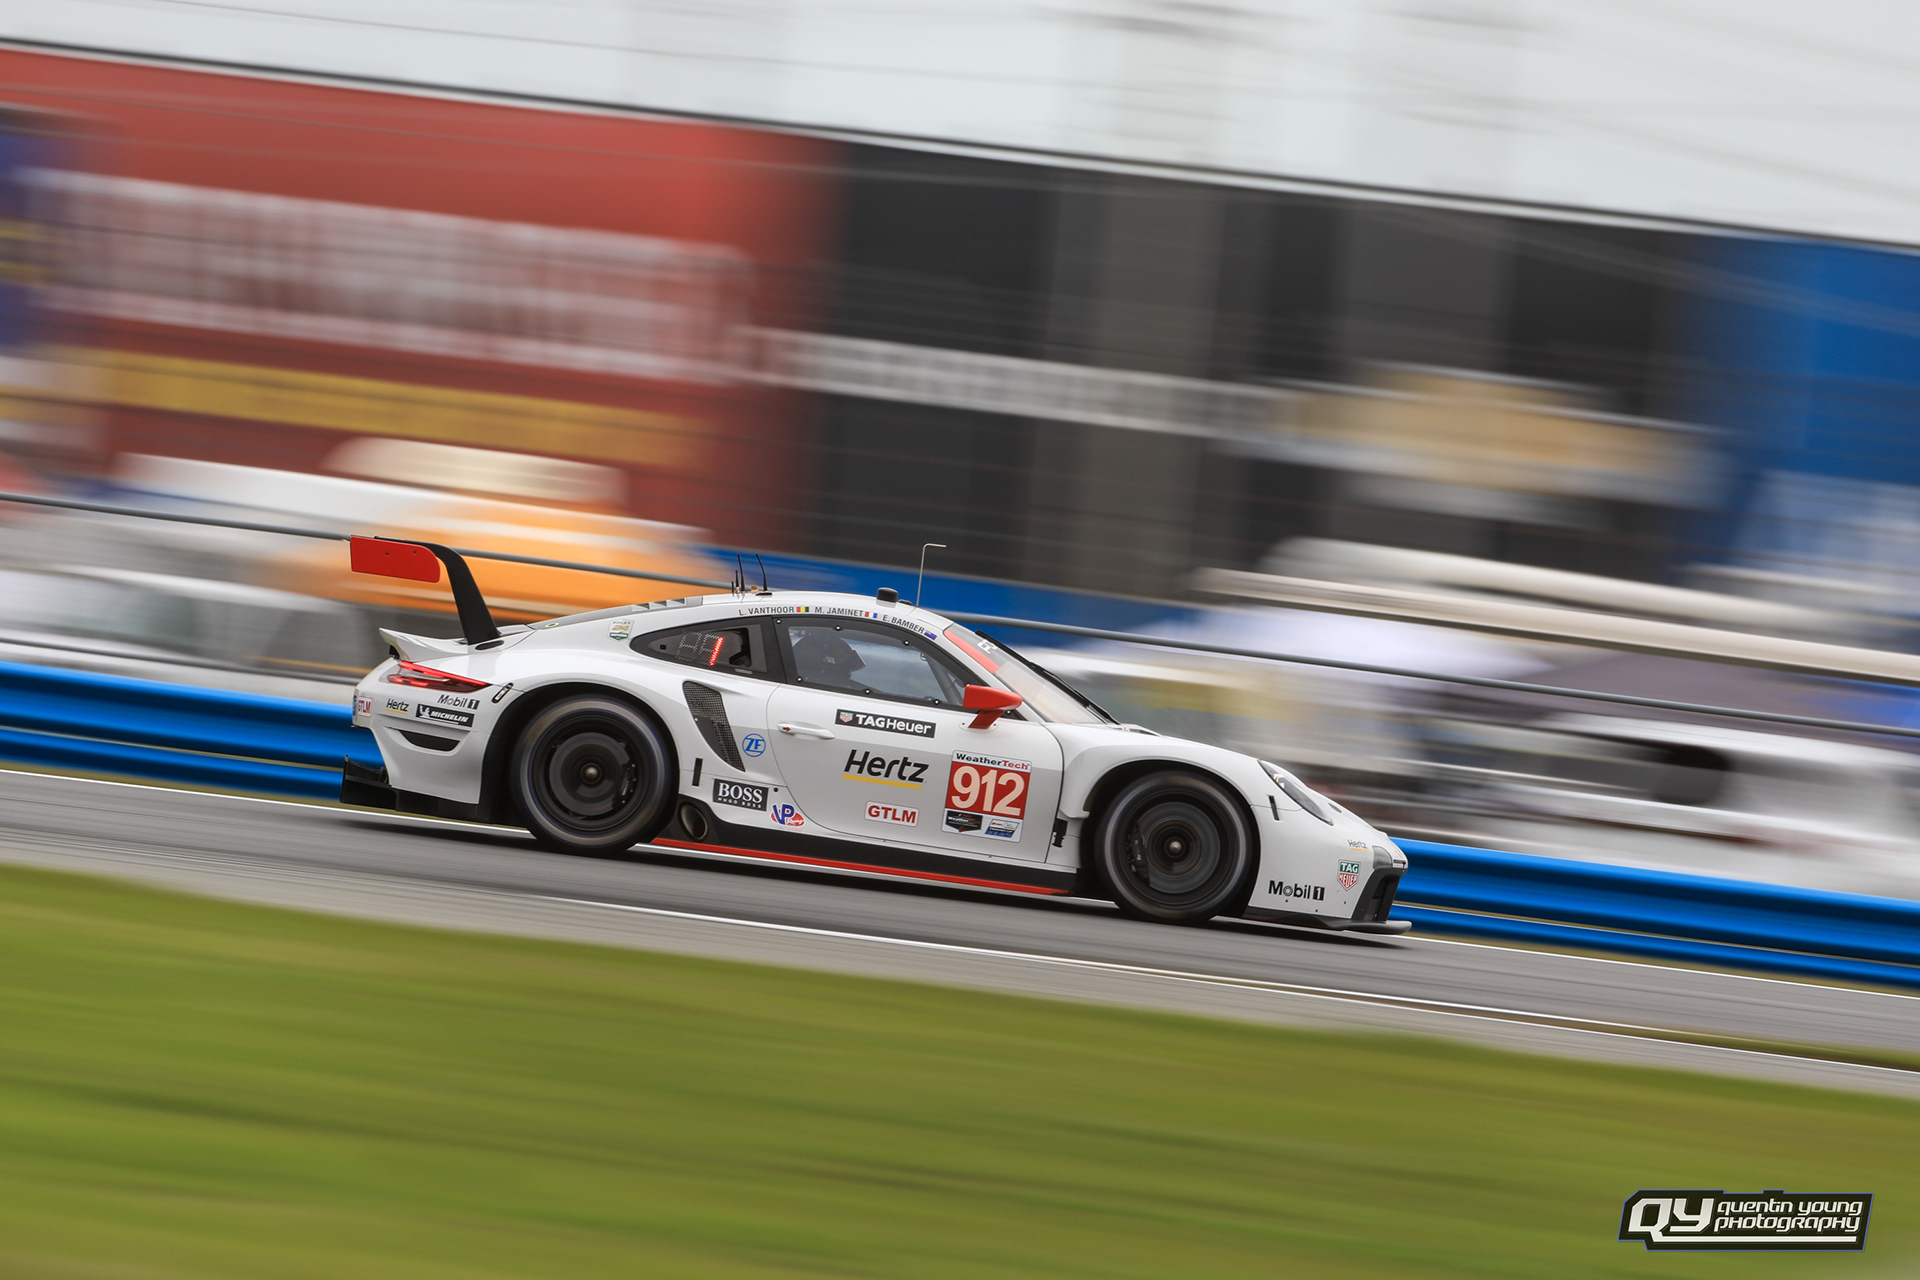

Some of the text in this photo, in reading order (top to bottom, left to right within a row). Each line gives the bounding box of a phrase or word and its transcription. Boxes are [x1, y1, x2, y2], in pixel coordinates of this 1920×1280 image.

[748, 606, 795, 615] VANTHOOR
[814, 606, 864, 617] M. JAMINET
[882, 615, 925, 634] E. BAMBER
[386, 699, 409, 712] Hertz
[437, 694, 468, 708] Mobil
[430, 710, 469, 723] MICHELIN
[744, 737, 763, 752] ZF
[844, 749, 930, 783] Hertz
[956, 752, 1029, 770] WeatherTech
[717, 782, 763, 803] BOSS
[951, 765, 1025, 816] 912
[772, 804, 795, 825] VP
[867, 804, 917, 824] GTLM
[1340, 862, 1359, 873] TAG
[1268, 880, 1312, 899] Mobil
